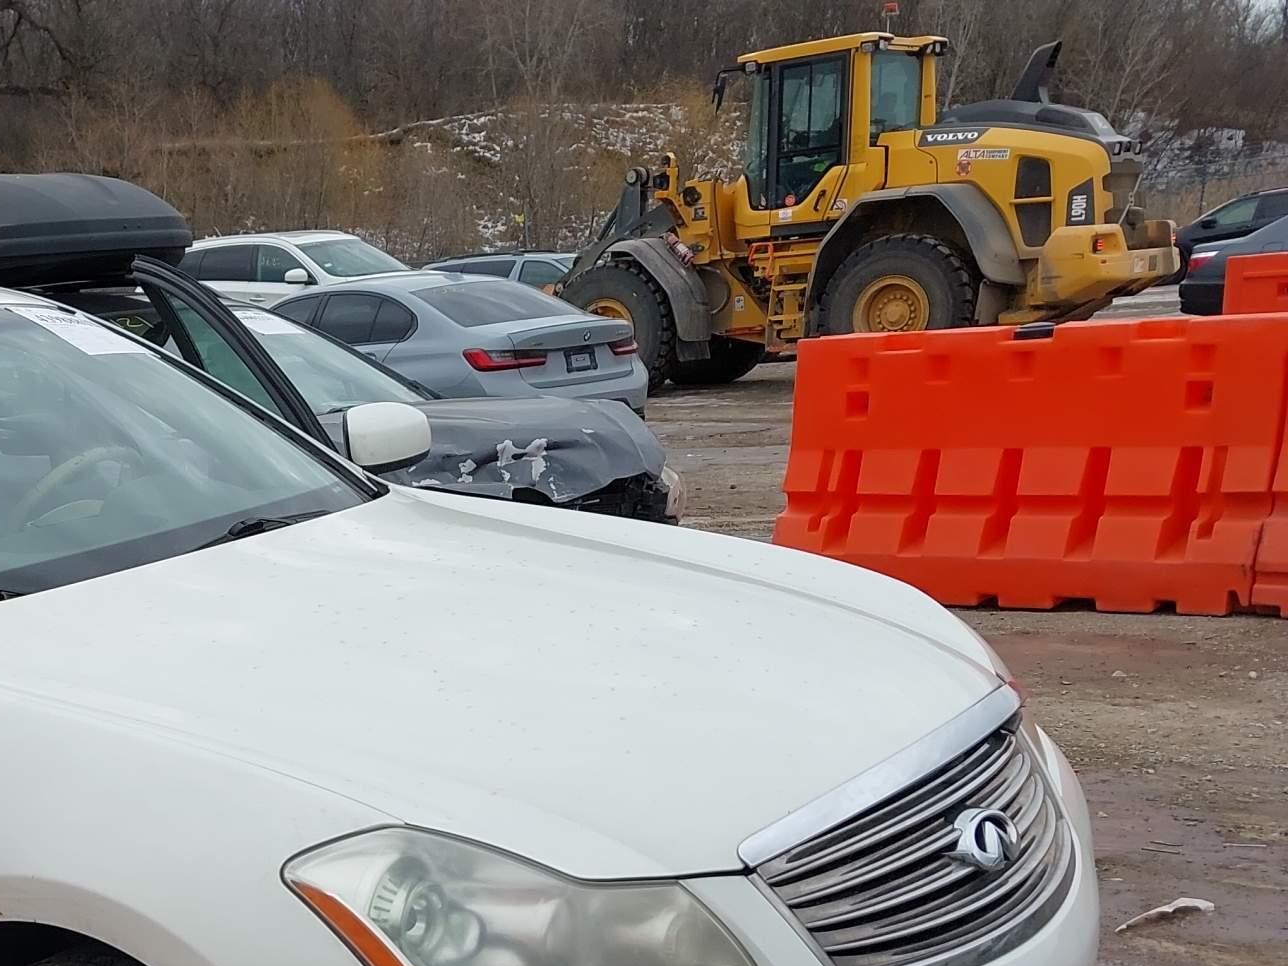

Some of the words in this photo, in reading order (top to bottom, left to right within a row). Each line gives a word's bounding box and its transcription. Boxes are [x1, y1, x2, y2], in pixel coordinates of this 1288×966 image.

[925, 131, 979, 142] VOLVO
[960, 150, 986, 159] ALTA
[1071, 195, 1087, 221] L90H
